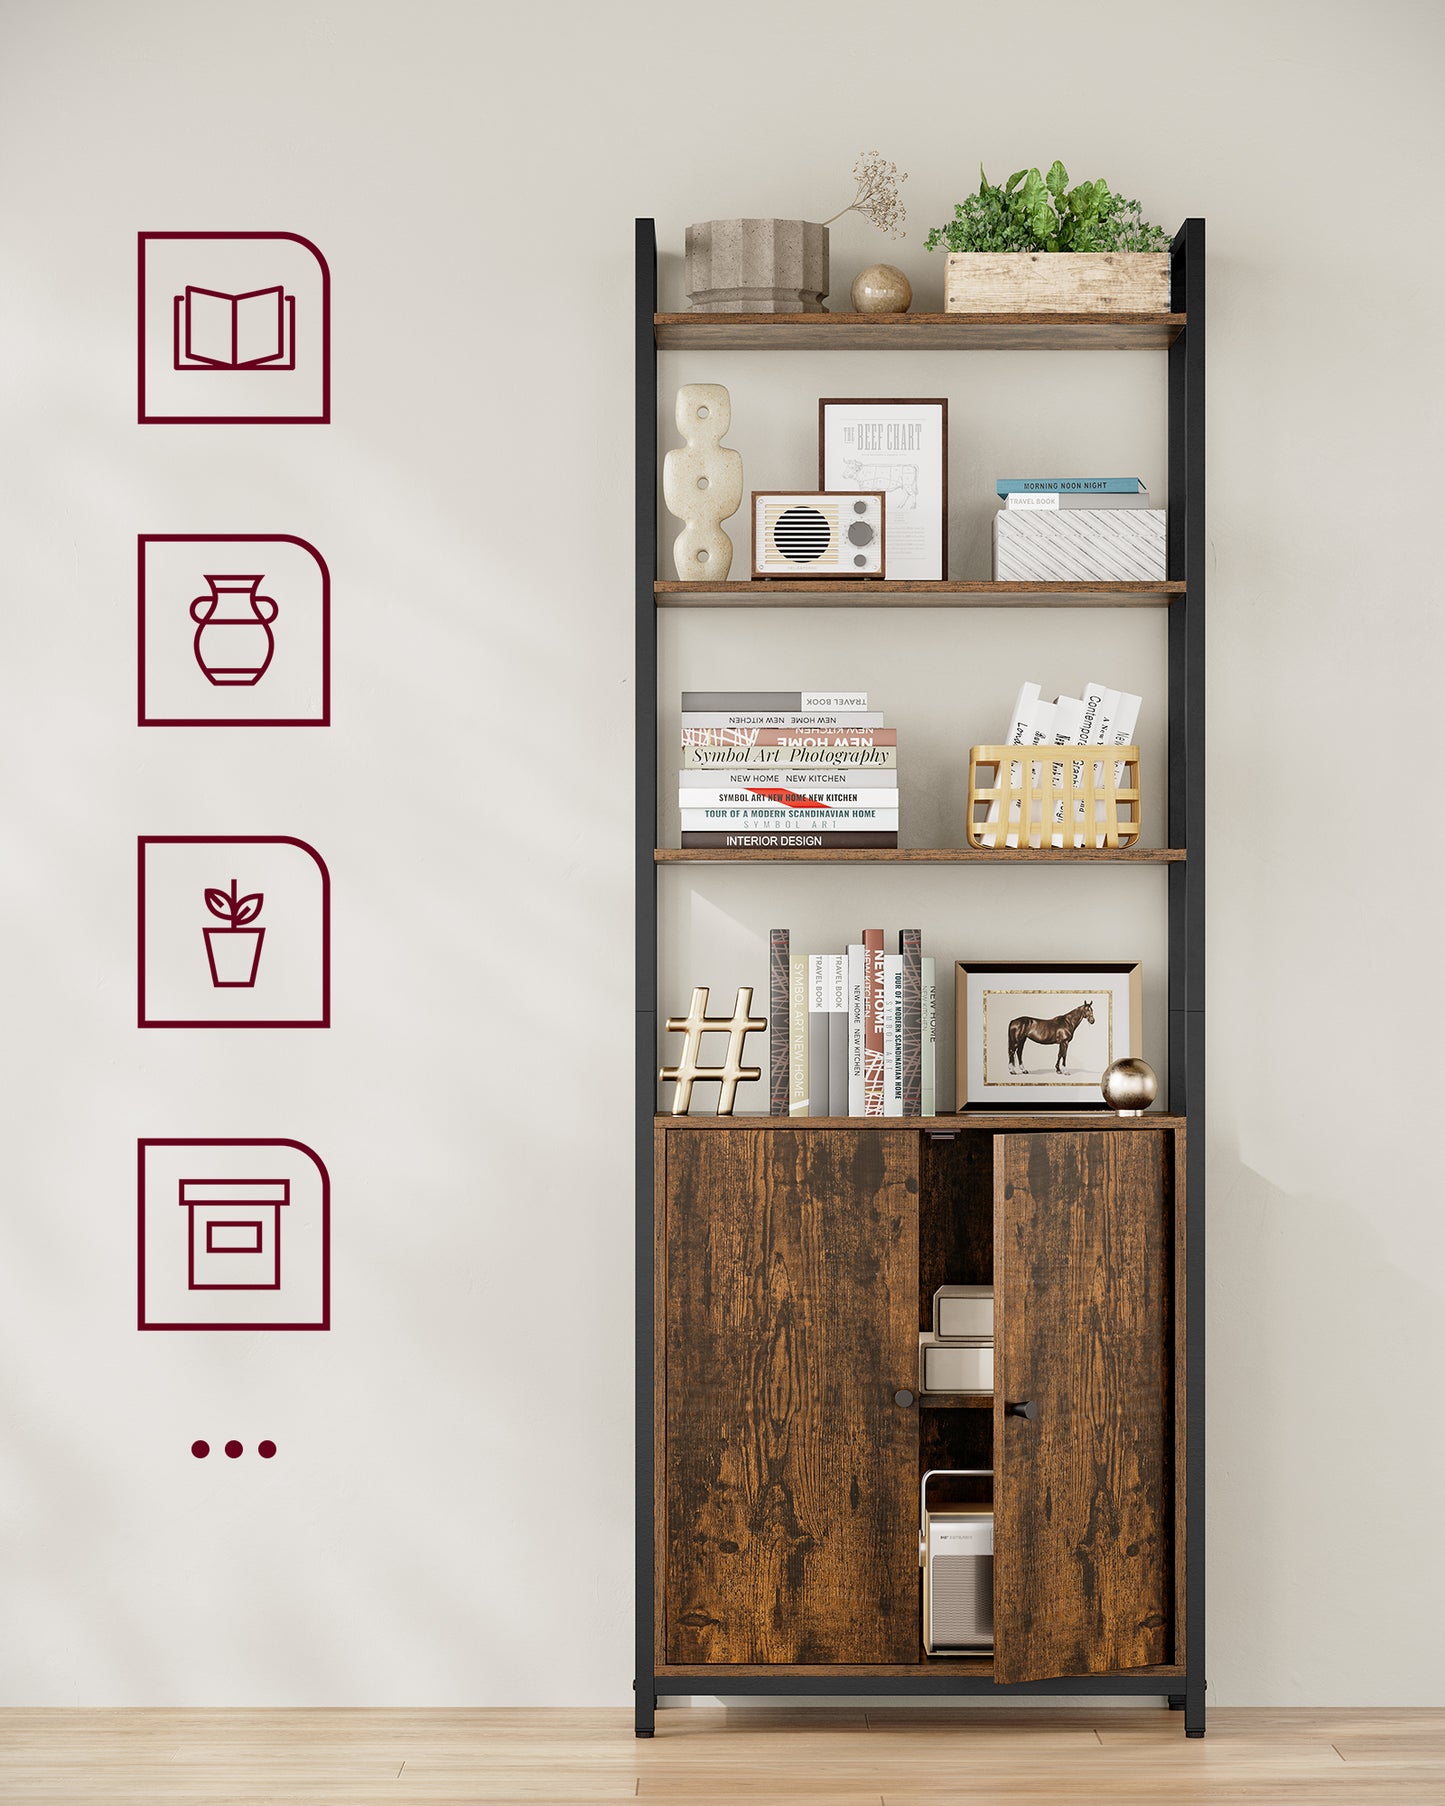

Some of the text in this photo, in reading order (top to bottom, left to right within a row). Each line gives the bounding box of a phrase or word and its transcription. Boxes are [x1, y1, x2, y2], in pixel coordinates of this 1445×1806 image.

[857, 424, 884, 450] BEEF
[886, 424, 922, 450] CHART
[1023, 482, 1058, 490] MORNING
[1060, 482, 1082, 490] NOON
[806, 698, 866, 706] TRAVEL BOOK
[1077, 695, 1102, 746] Contempora
[777, 737, 874, 747] NEW HOME
[1012, 722, 1028, 746] Lond
[692, 747, 889, 766] Symbol Art Photography
[719, 794, 858, 802] SYMBOL ART NEW HOME NEW KITCHEN
[705, 810, 876, 818] TOUR OF A MODERN SCANDINAVIAN HOME
[744, 820, 837, 828] SYMBOL ART
[726, 836, 822, 846] INTERIOR DESIGN
[894, 972, 902, 989] TOUR
[874, 950, 884, 1034] NEW HOME
[894, 991, 902, 1000] OF
[894, 1006, 902, 1032] MODERN
[794, 963, 804, 1097] SYMBOL ART NEW HOME
[894, 1034, 902, 1080] SCANDINAVIAN
[894, 1082, 902, 1099] HOME
